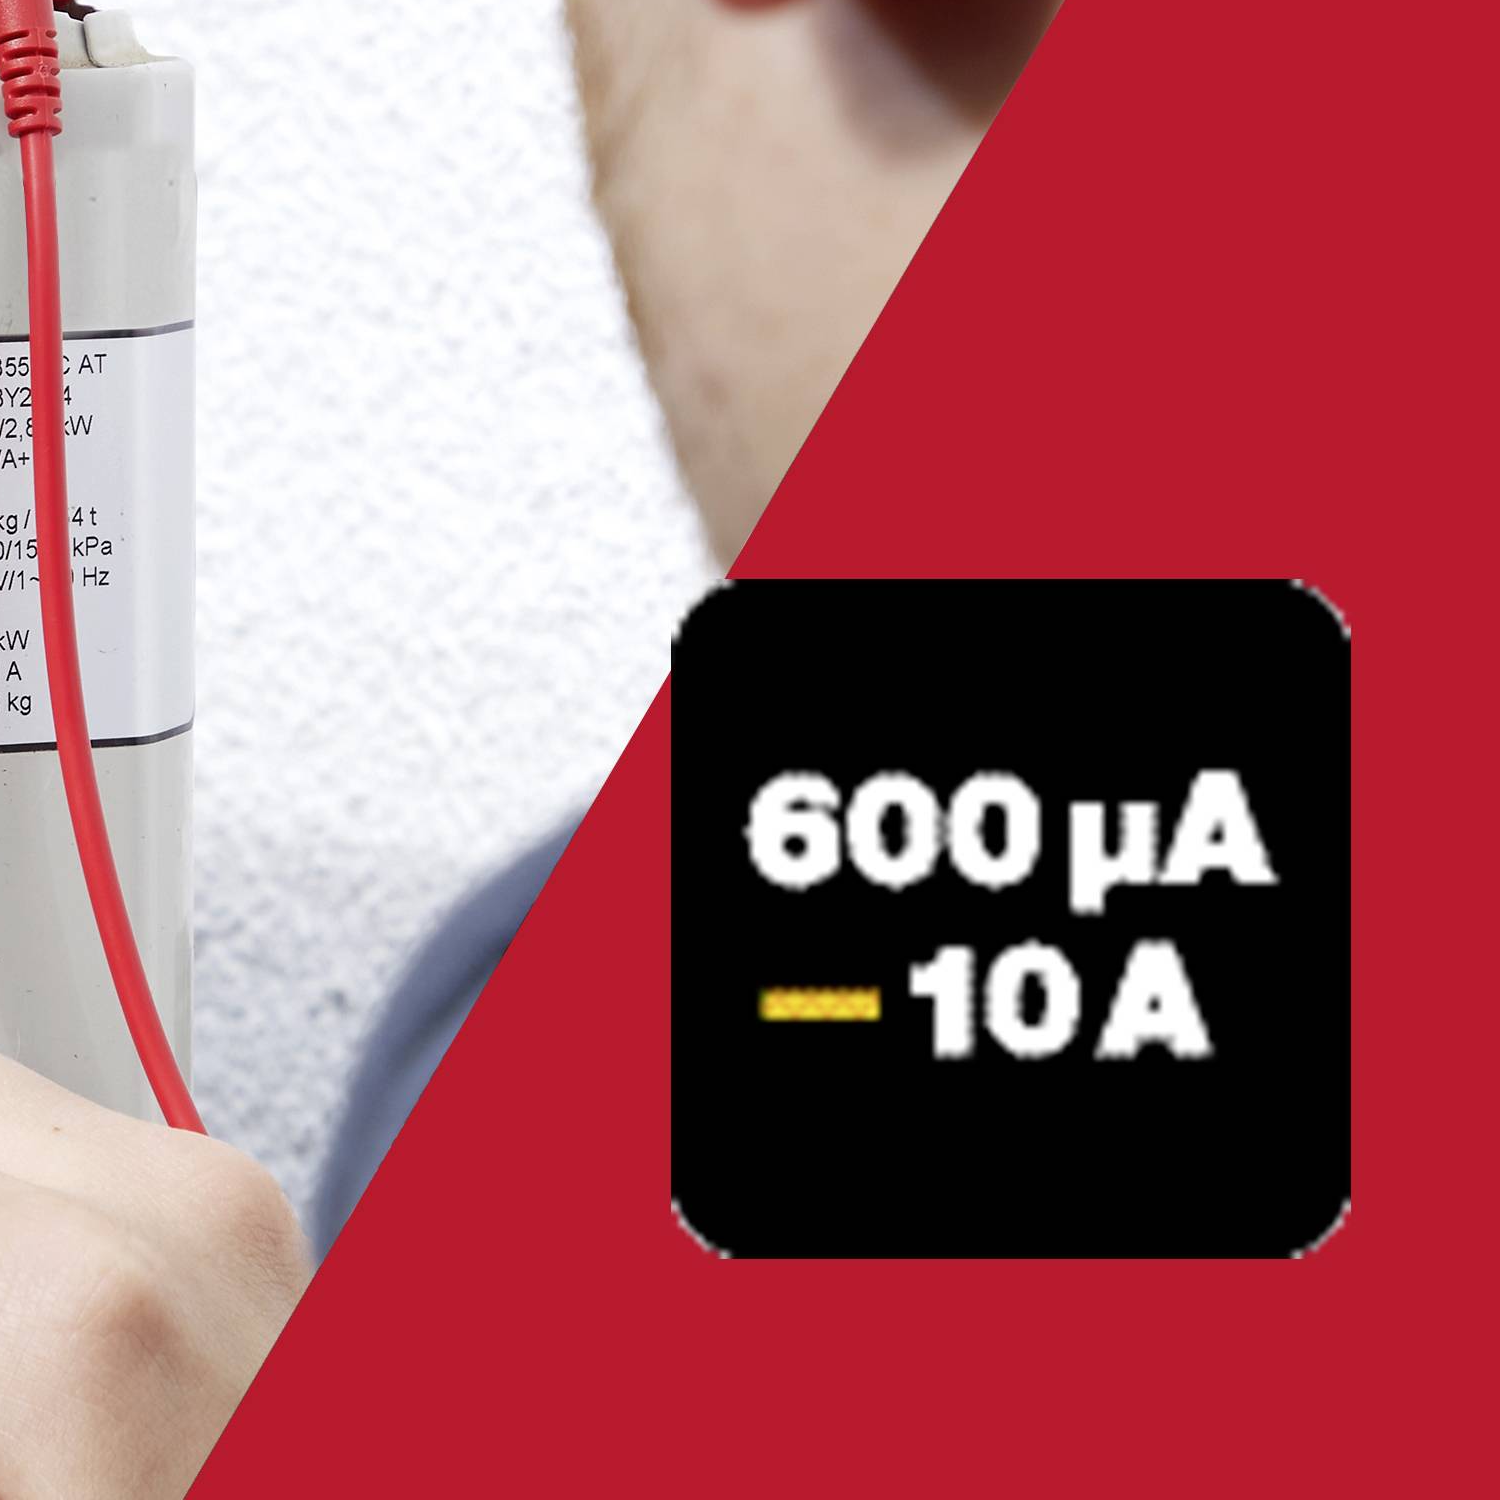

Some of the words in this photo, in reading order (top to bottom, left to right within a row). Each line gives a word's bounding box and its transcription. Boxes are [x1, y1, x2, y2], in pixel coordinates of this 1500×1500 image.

[79, 353, 108, 375] AT
[73, 536, 113, 557] kPa
[83, 566, 110, 587] Hz
[6, 661, 22, 682] A
[7, 691, 32, 716] kg
